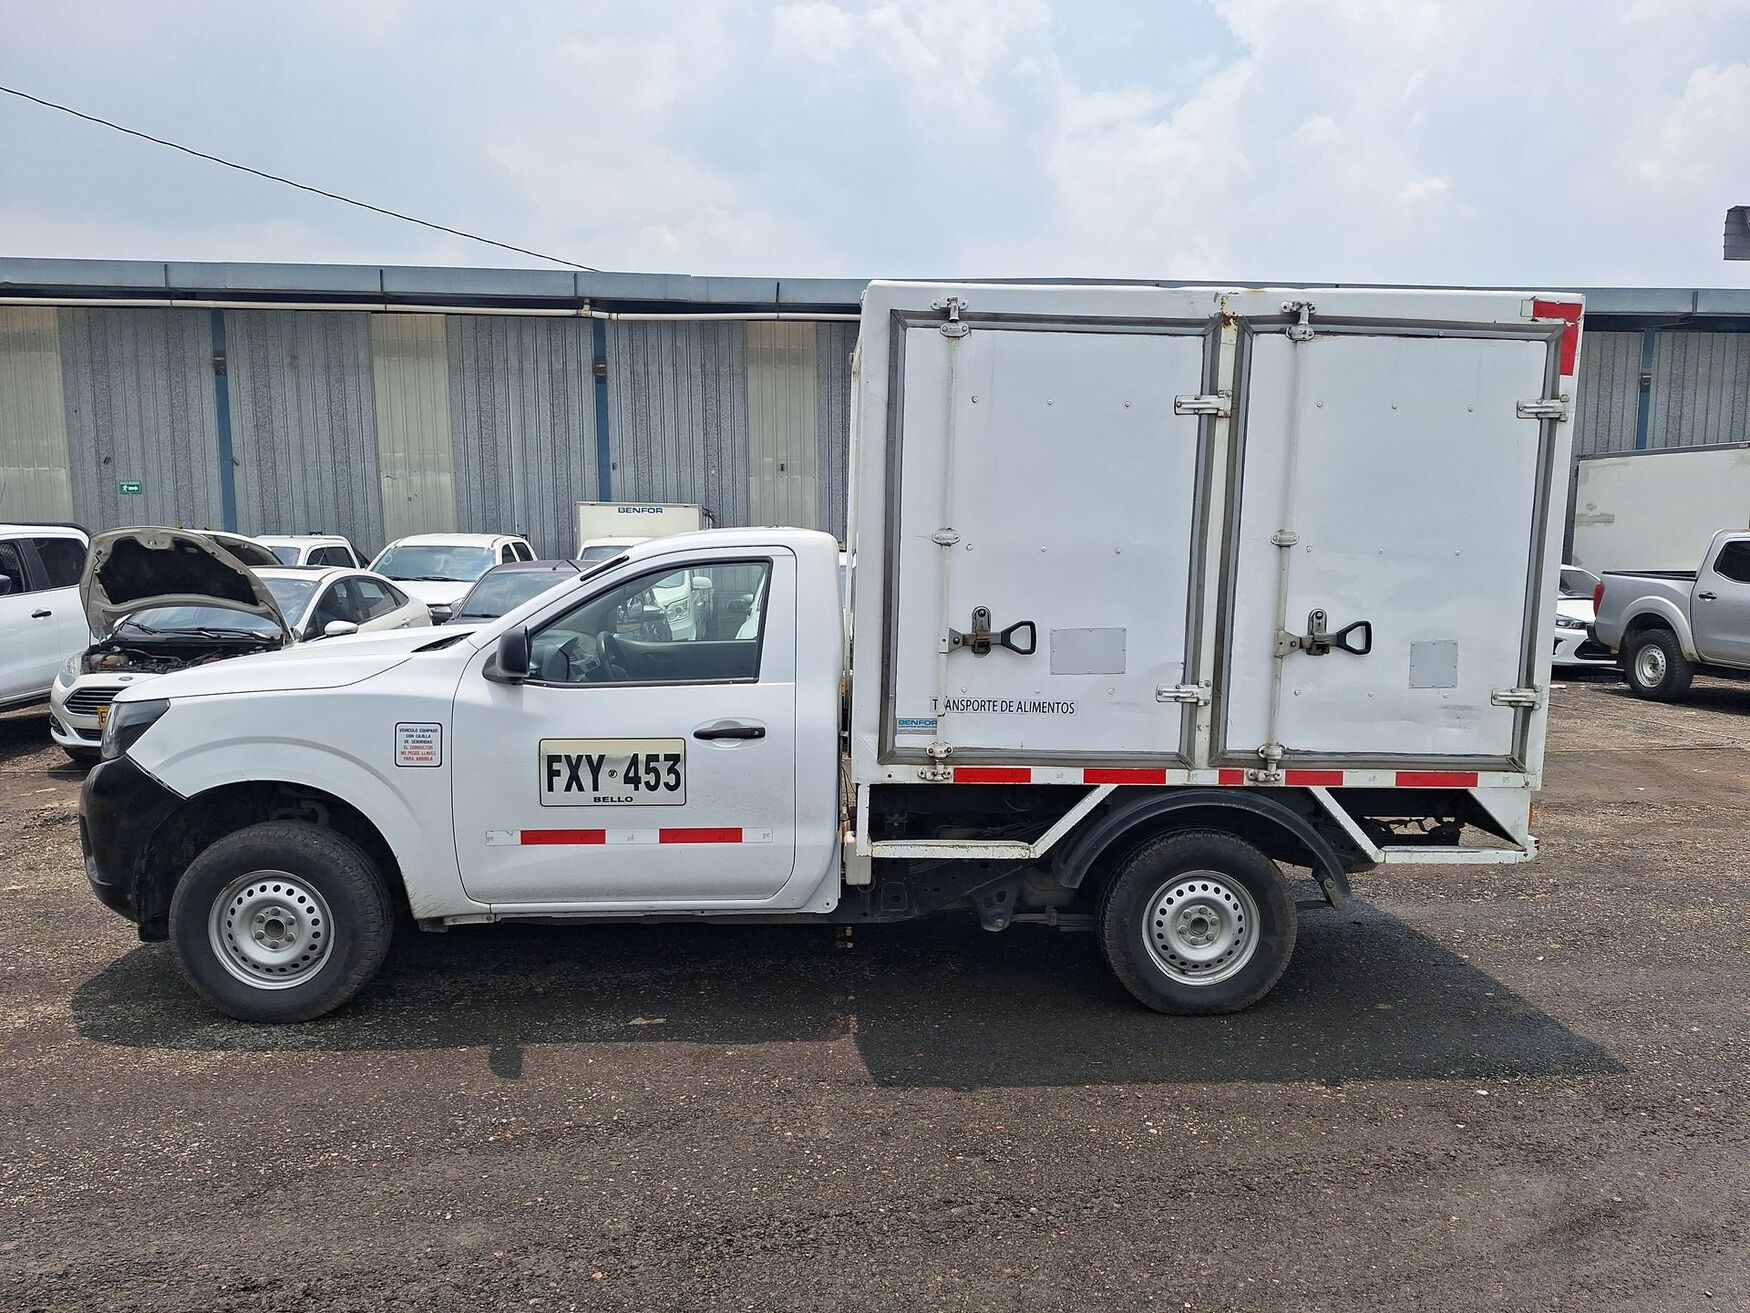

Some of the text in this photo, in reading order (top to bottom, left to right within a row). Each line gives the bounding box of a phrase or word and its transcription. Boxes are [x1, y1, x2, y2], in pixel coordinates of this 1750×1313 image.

[617, 506, 664, 514] BENFOR
[932, 698, 1076, 715] TANSPORTE DE ALIMENTOS
[546, 753, 681, 793] FXY 453
